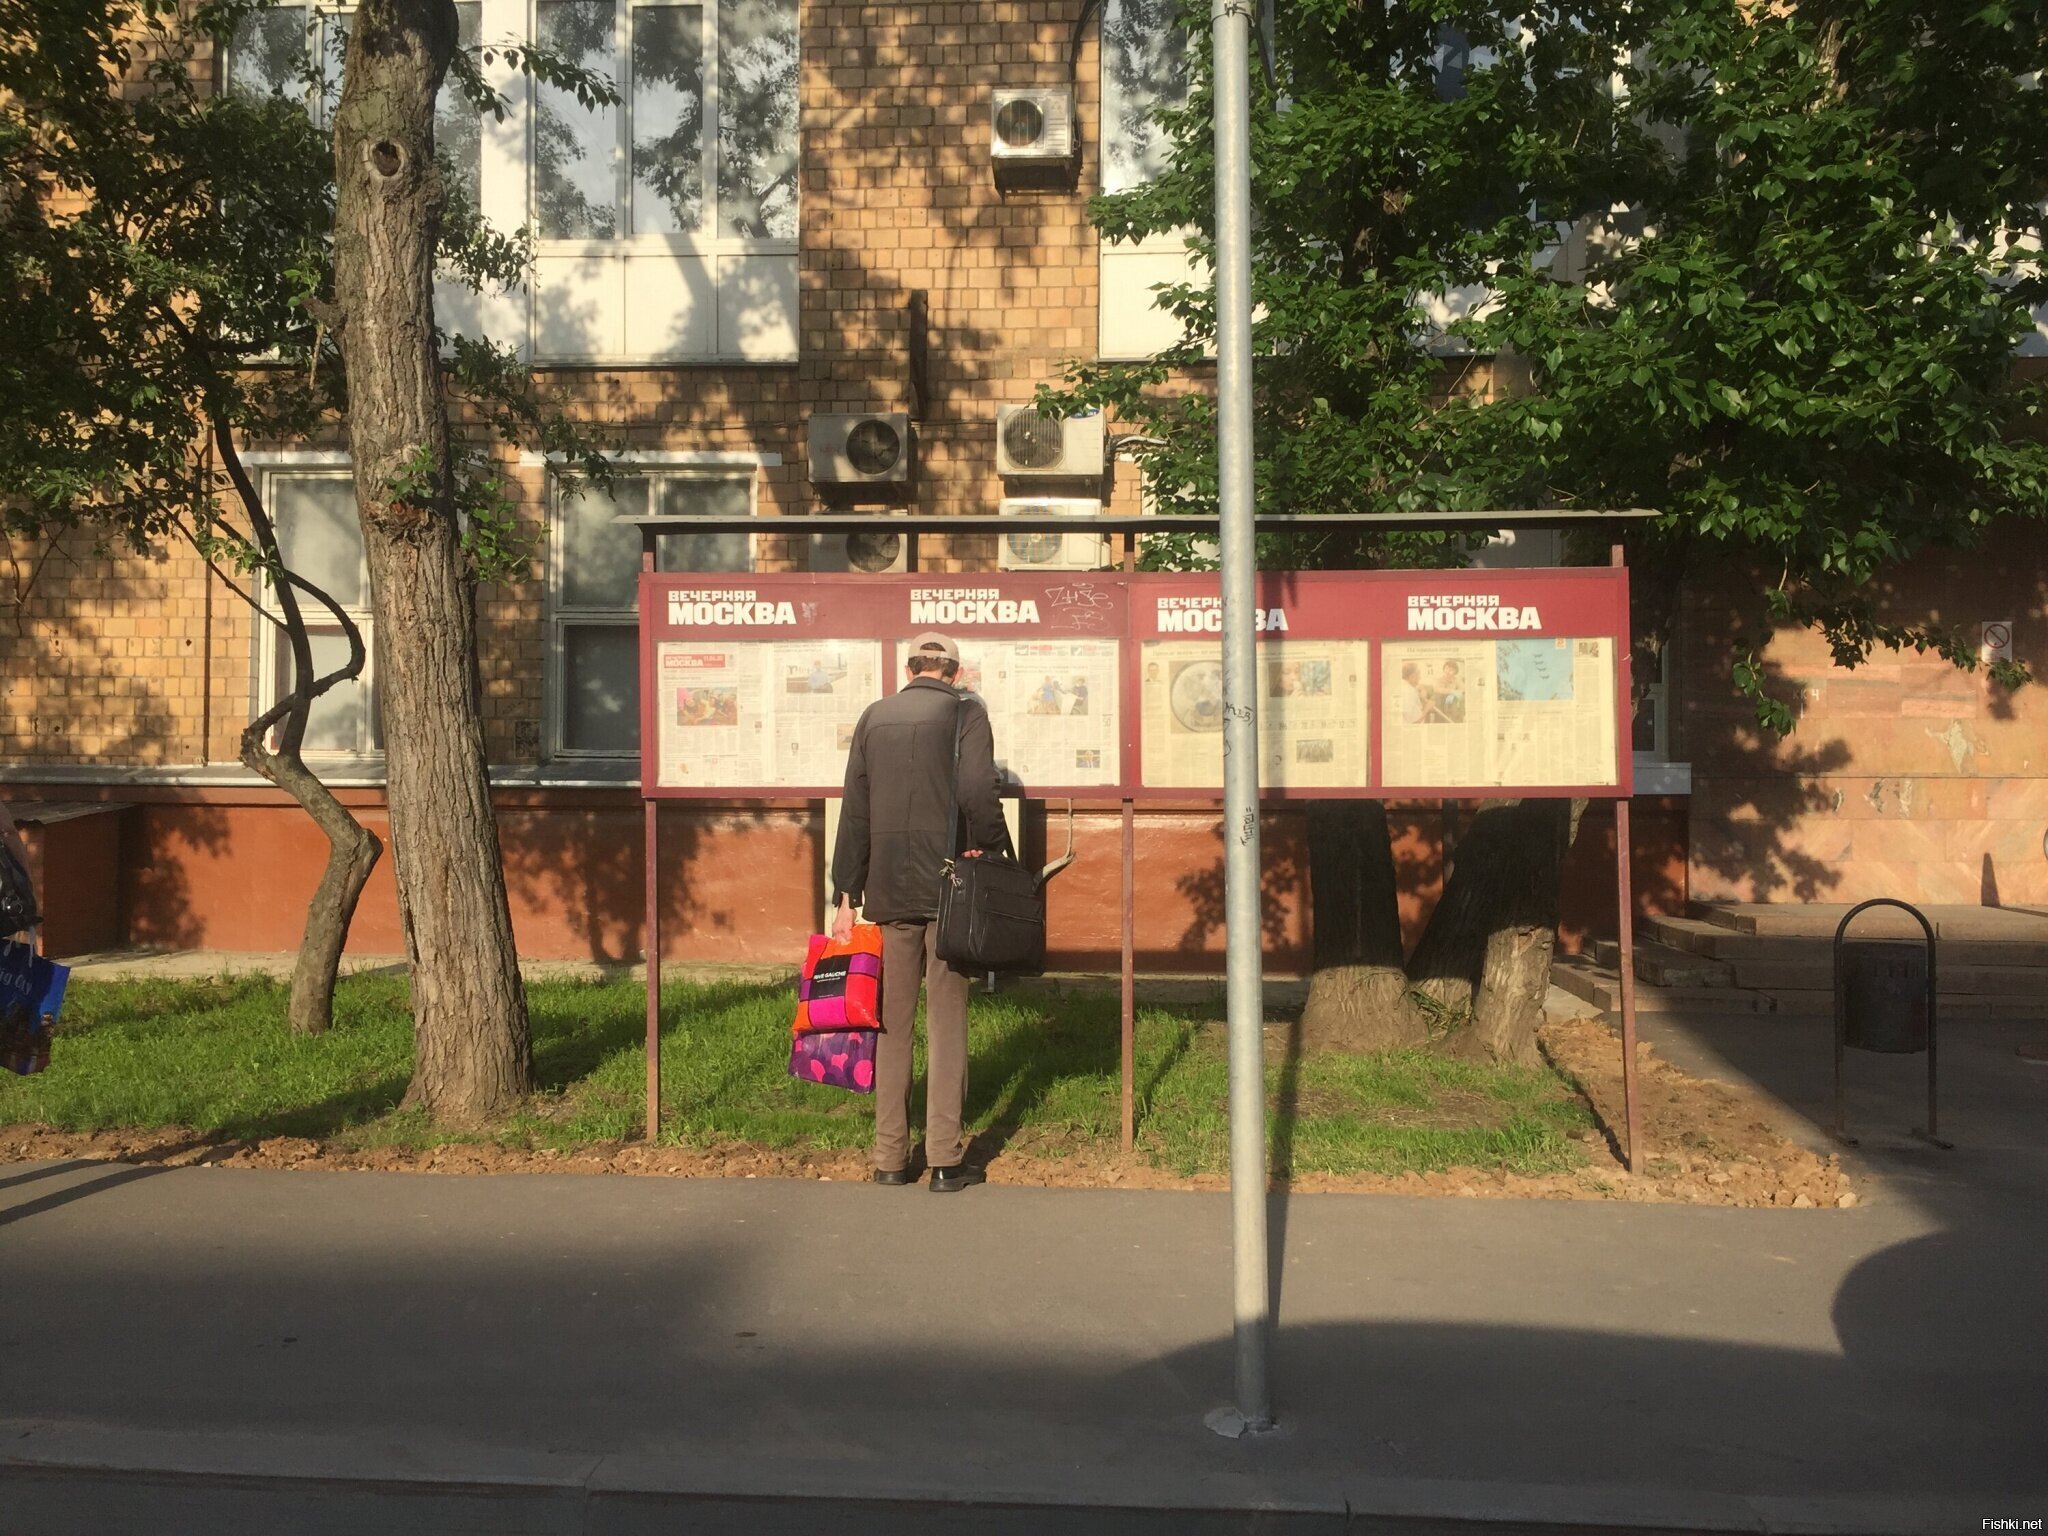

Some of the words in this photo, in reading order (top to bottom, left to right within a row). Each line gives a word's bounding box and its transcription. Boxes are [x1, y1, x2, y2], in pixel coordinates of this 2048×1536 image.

[668, 590, 757, 601] ВЕЧЕРНЯЯ
[911, 589, 999, 600] ВЕЧЕРНЯЯ
[1408, 595, 1500, 606] ВЕЧЕРНЯЯ
[911, 600, 1040, 624] МОСКВА
[1157, 598, 1222, 609] ВЕЧЕРН
[668, 602, 797, 625] МОСКВА
[1157, 608, 1289, 632] МОСВА
[1408, 607, 1542, 630] МОСКВА
